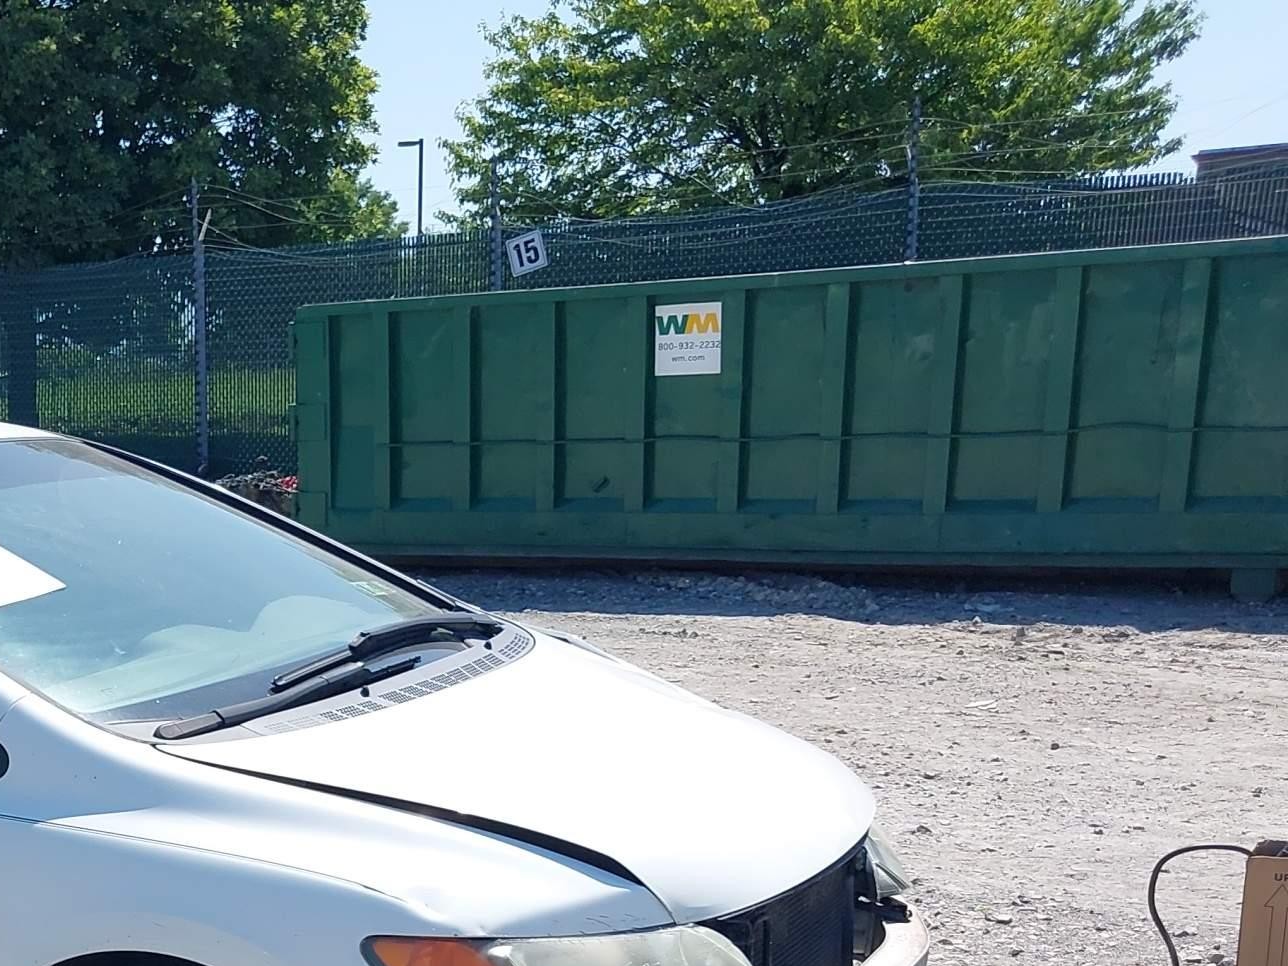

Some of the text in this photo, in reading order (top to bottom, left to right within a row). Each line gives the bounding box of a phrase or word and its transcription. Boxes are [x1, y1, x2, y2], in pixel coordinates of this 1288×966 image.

[513, 238, 539, 267] 15
[656, 313, 719, 335] WM
[658, 341, 720, 350] 800-932-2232
